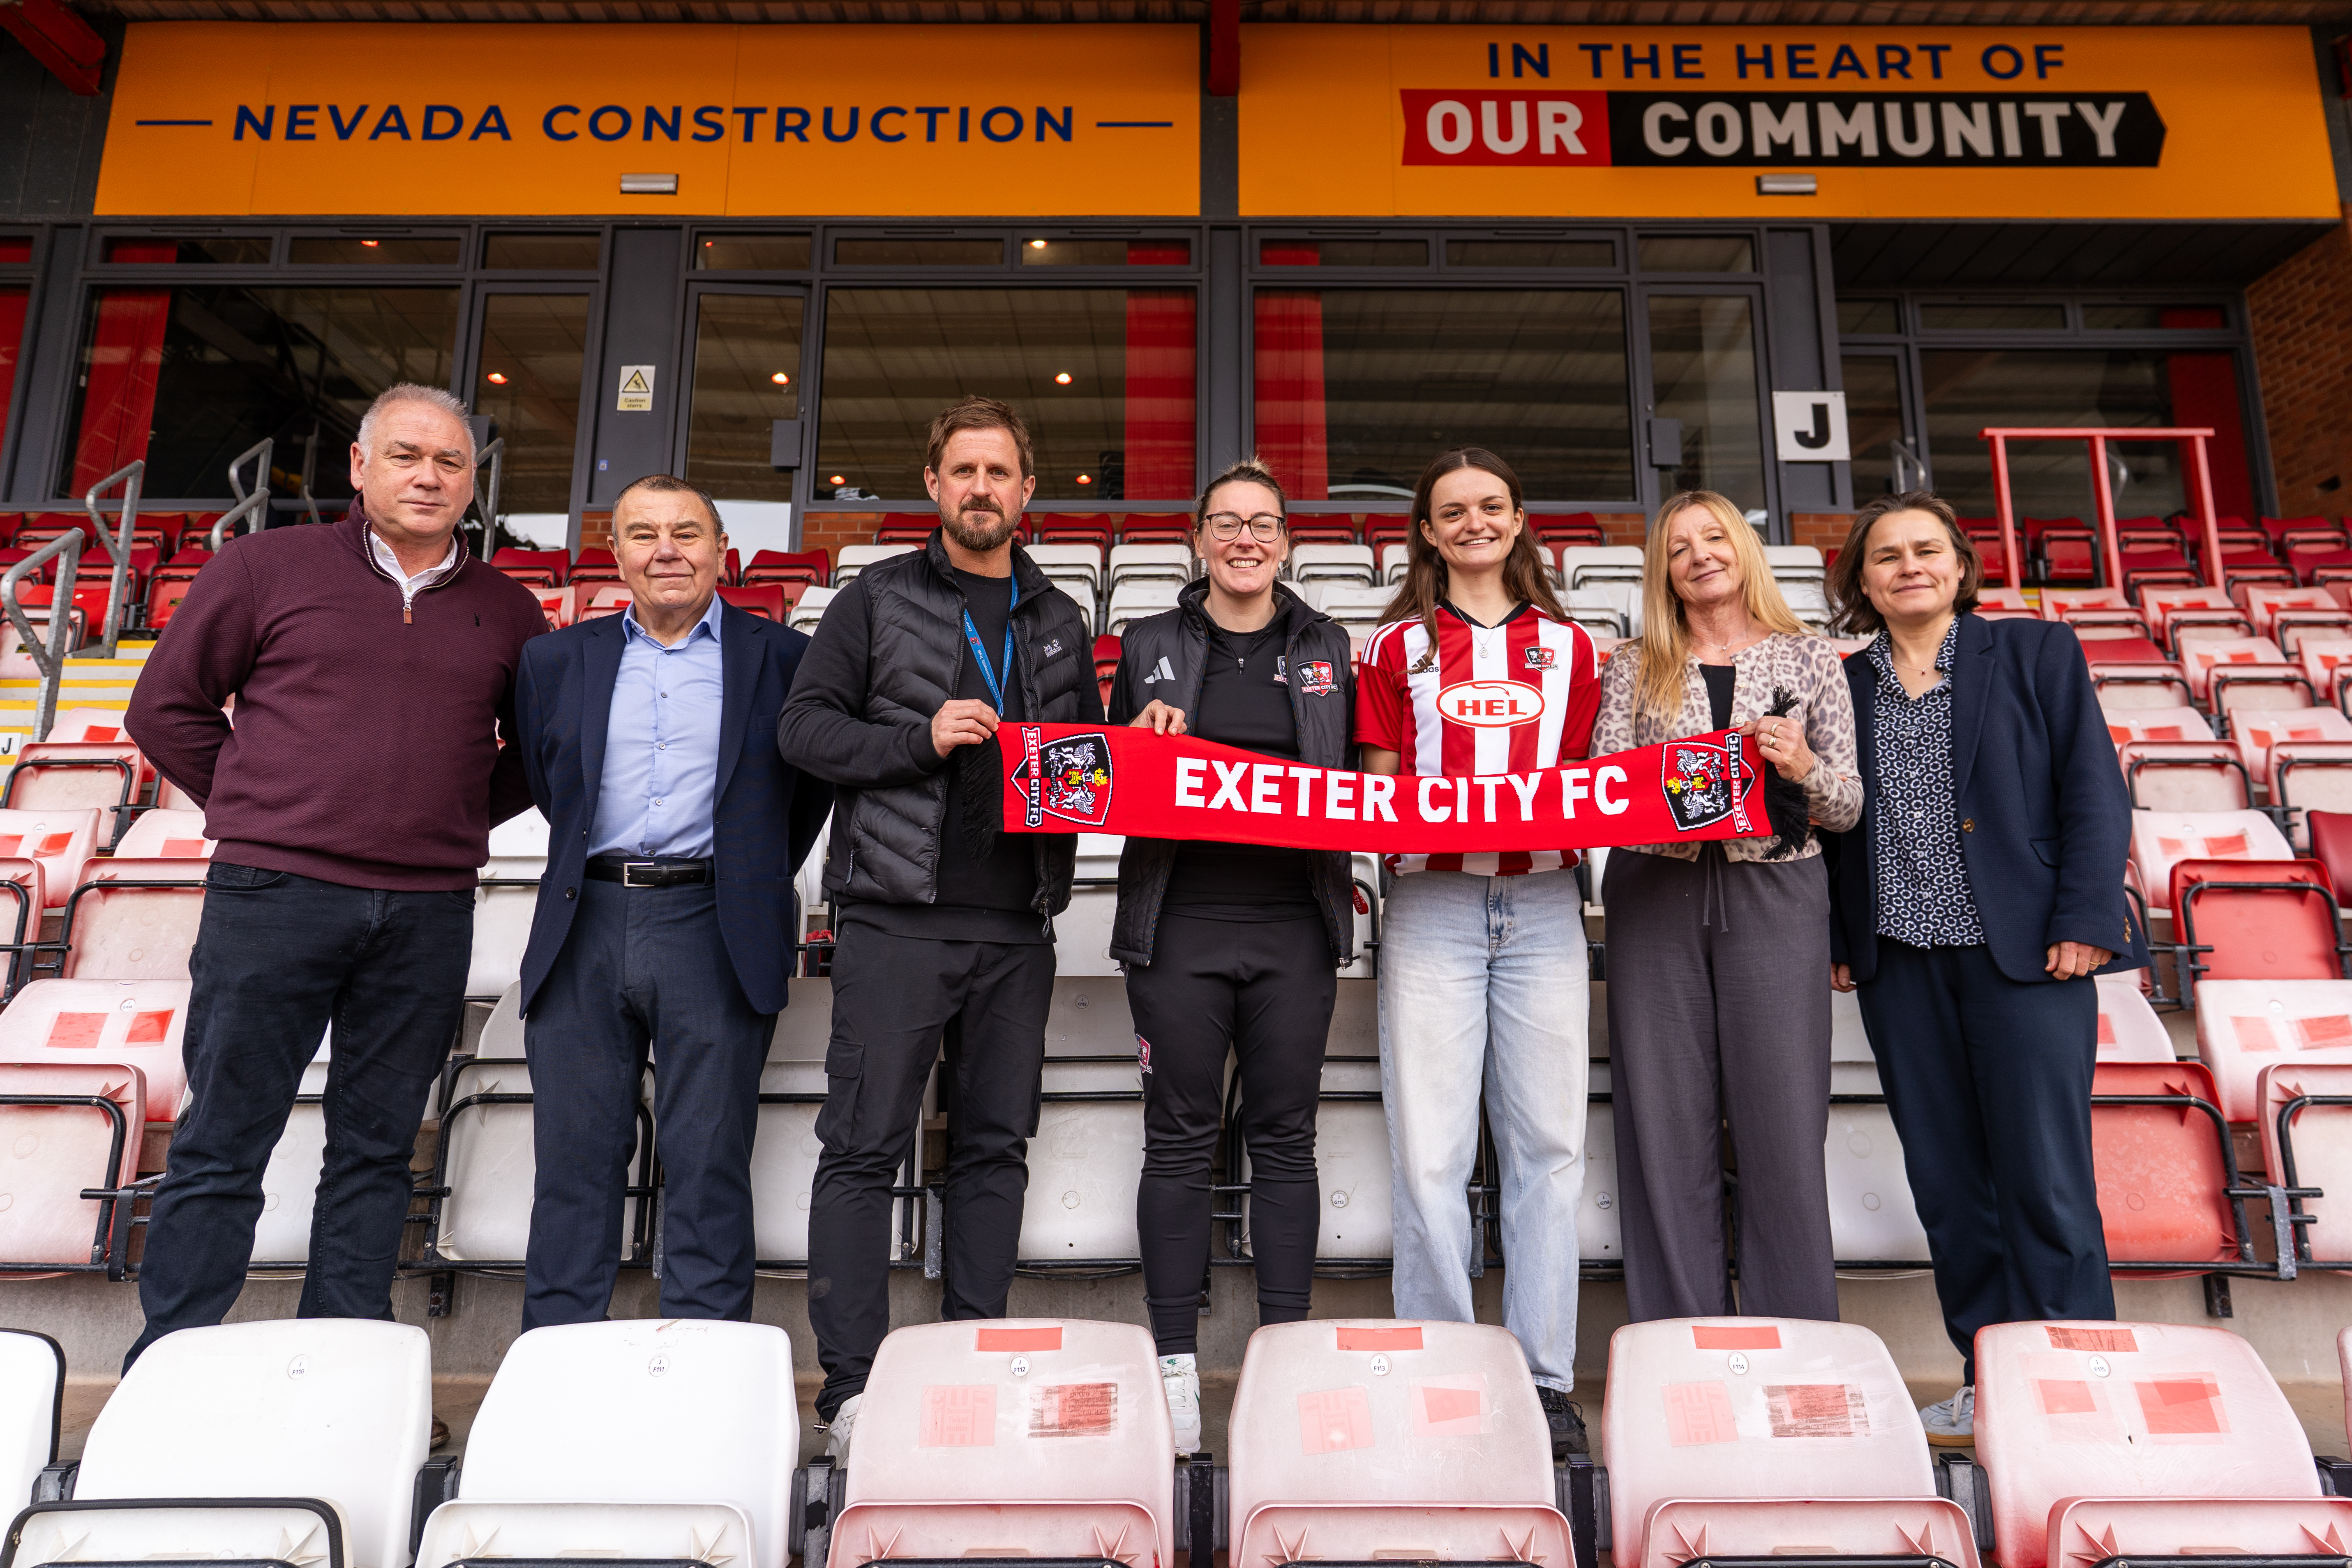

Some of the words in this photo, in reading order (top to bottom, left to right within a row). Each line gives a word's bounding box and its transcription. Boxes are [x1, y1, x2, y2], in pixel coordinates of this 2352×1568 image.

[1488, 43, 1549, 78] IN
[1578, 43, 1705, 79] THE
[1735, 44, 1952, 80] HEART
[1981, 44, 2064, 80] OF
[232, 104, 512, 141] NEVADA
[542, 104, 1073, 143] CONSTRUCTION
[1426, 99, 1588, 155] OUR
[1644, 101, 2126, 157] COMMUNITY
[1794, 403, 1830, 449] J
[1043, 644, 1052, 652] Jack
[1045, 646, 1062, 658] Wolfskin
[981, 659, 991, 679] Community
[1457, 699, 1528, 716] HEL
[2, 738, 12, 754] J
[1027, 732, 1040, 777] EXETER
[1729, 737, 1738, 751] FC
[1730, 753, 1740, 778] CITY
[1029, 778, 1040, 806] CITY
[1175, 756, 1399, 822] EXETER
[1417, 771, 1543, 823] CITY
[1559, 765, 1629, 820] FC
[1732, 779, 1747, 827] EXETER
[1029, 808, 1039, 822] FC
[1353, 894, 1362, 912] STAFF
[1323, 1411, 1346, 1420] Season
